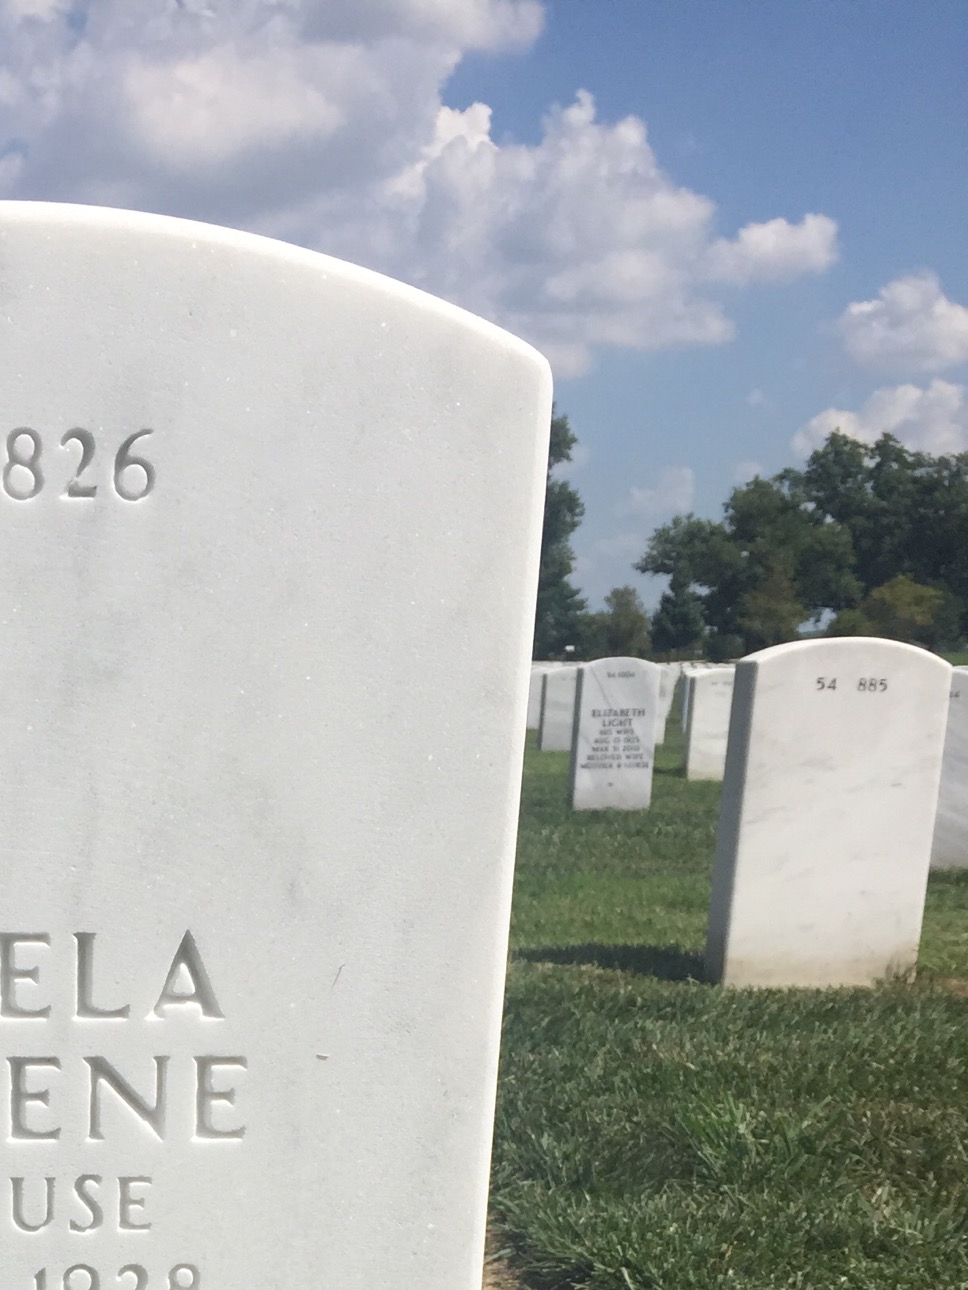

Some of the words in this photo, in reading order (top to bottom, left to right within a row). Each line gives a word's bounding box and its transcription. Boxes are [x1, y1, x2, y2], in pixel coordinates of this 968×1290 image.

[2, 426, 158, 502] 826
[816, 677, 837, 691] 54
[856, 678, 889, 692] 885
